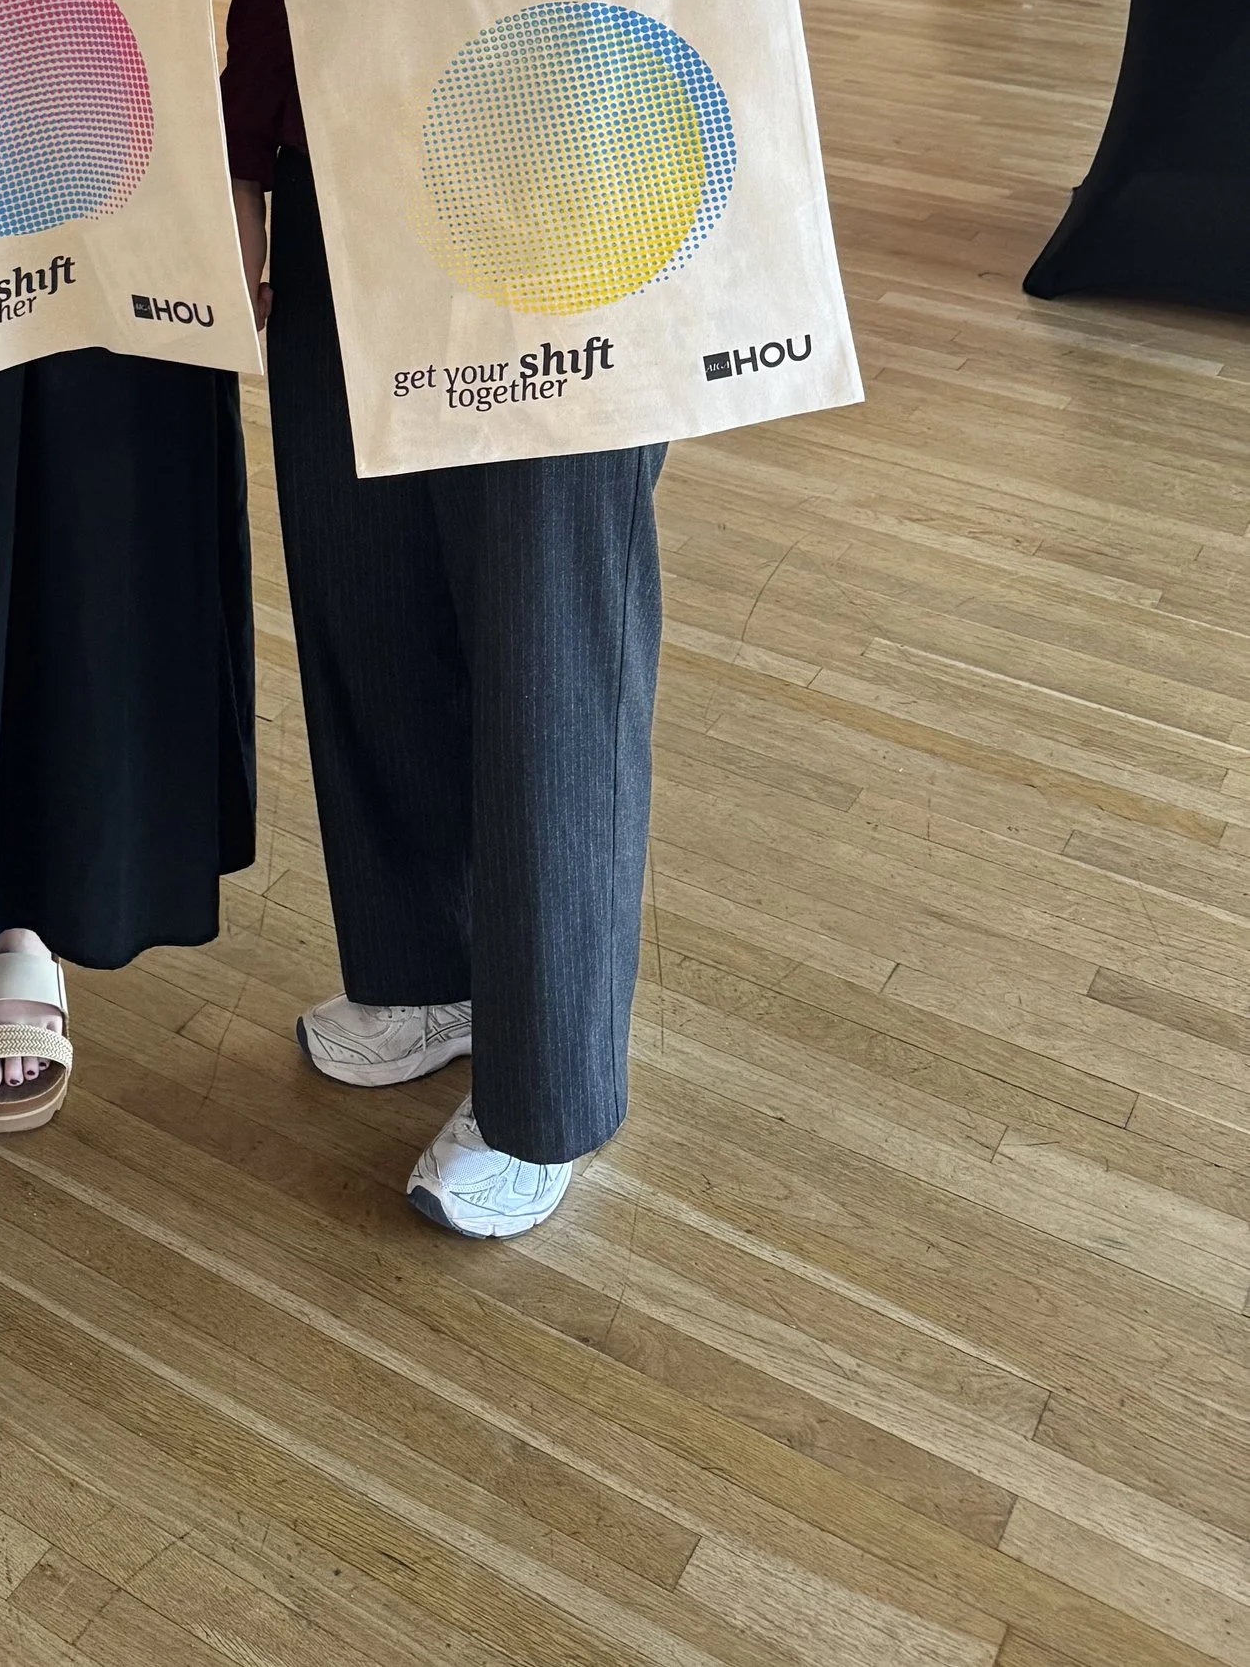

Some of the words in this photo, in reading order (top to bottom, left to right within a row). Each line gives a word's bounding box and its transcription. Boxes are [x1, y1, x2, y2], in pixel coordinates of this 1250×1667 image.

[152, 297, 215, 327] HOU
[732, 334, 812, 375] HOU
[393, 364, 437, 397] get
[443, 359, 509, 393] your
[446, 374, 568, 411] together
